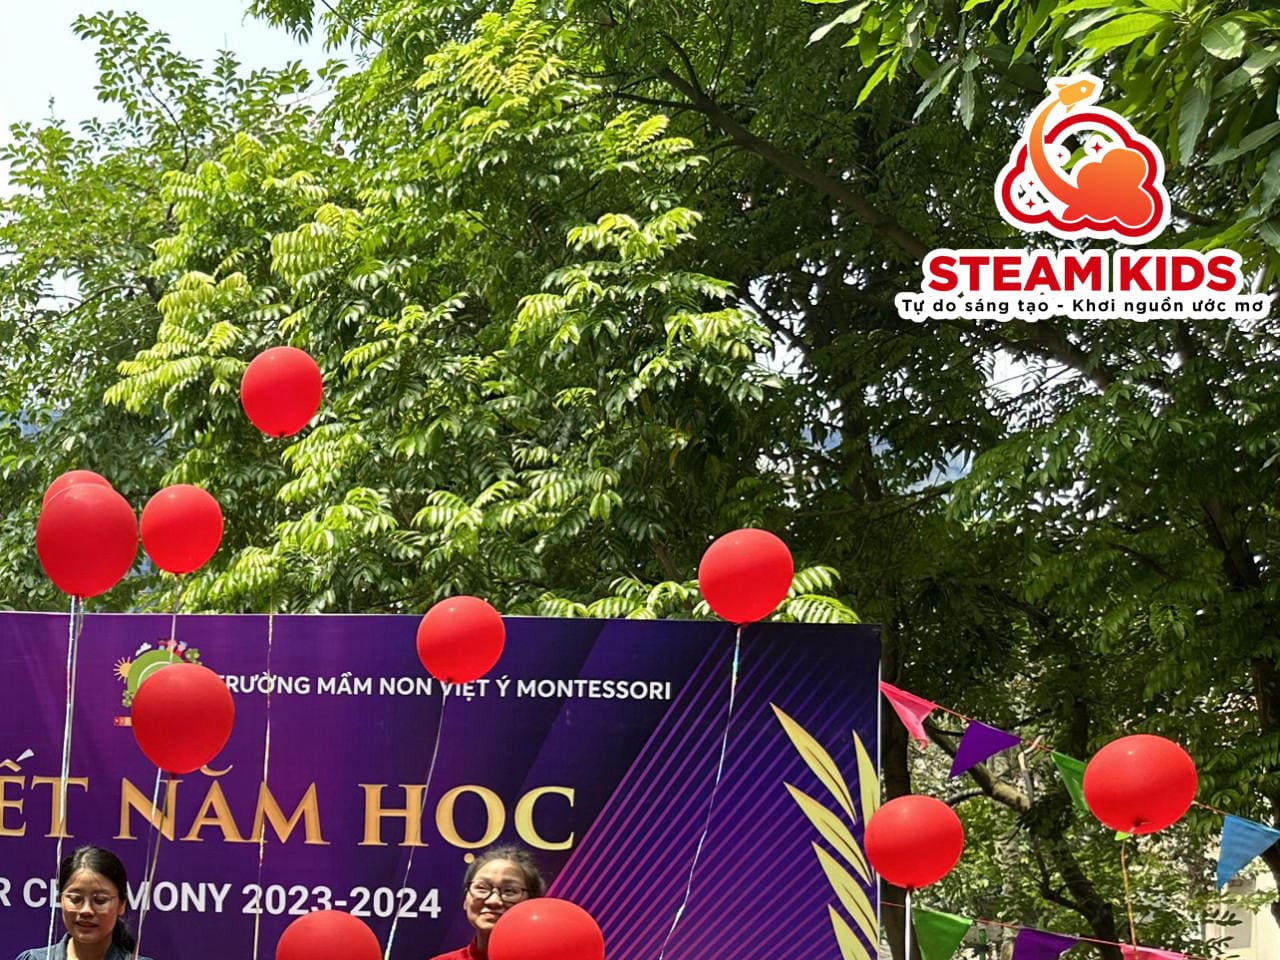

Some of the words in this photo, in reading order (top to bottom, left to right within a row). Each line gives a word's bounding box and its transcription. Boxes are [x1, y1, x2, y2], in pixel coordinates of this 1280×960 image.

[317, 671, 372, 696] MẦM
[379, 677, 432, 696] NON
[496, 675, 511, 697] Ý
[517, 678, 671, 700] MONTESSORI
[112, 763, 331, 842] NĂM
[357, 783, 575, 864] HỌC
[23, 876, 232, 913] CEMONY
[241, 883, 442, 919] 2023-2024
